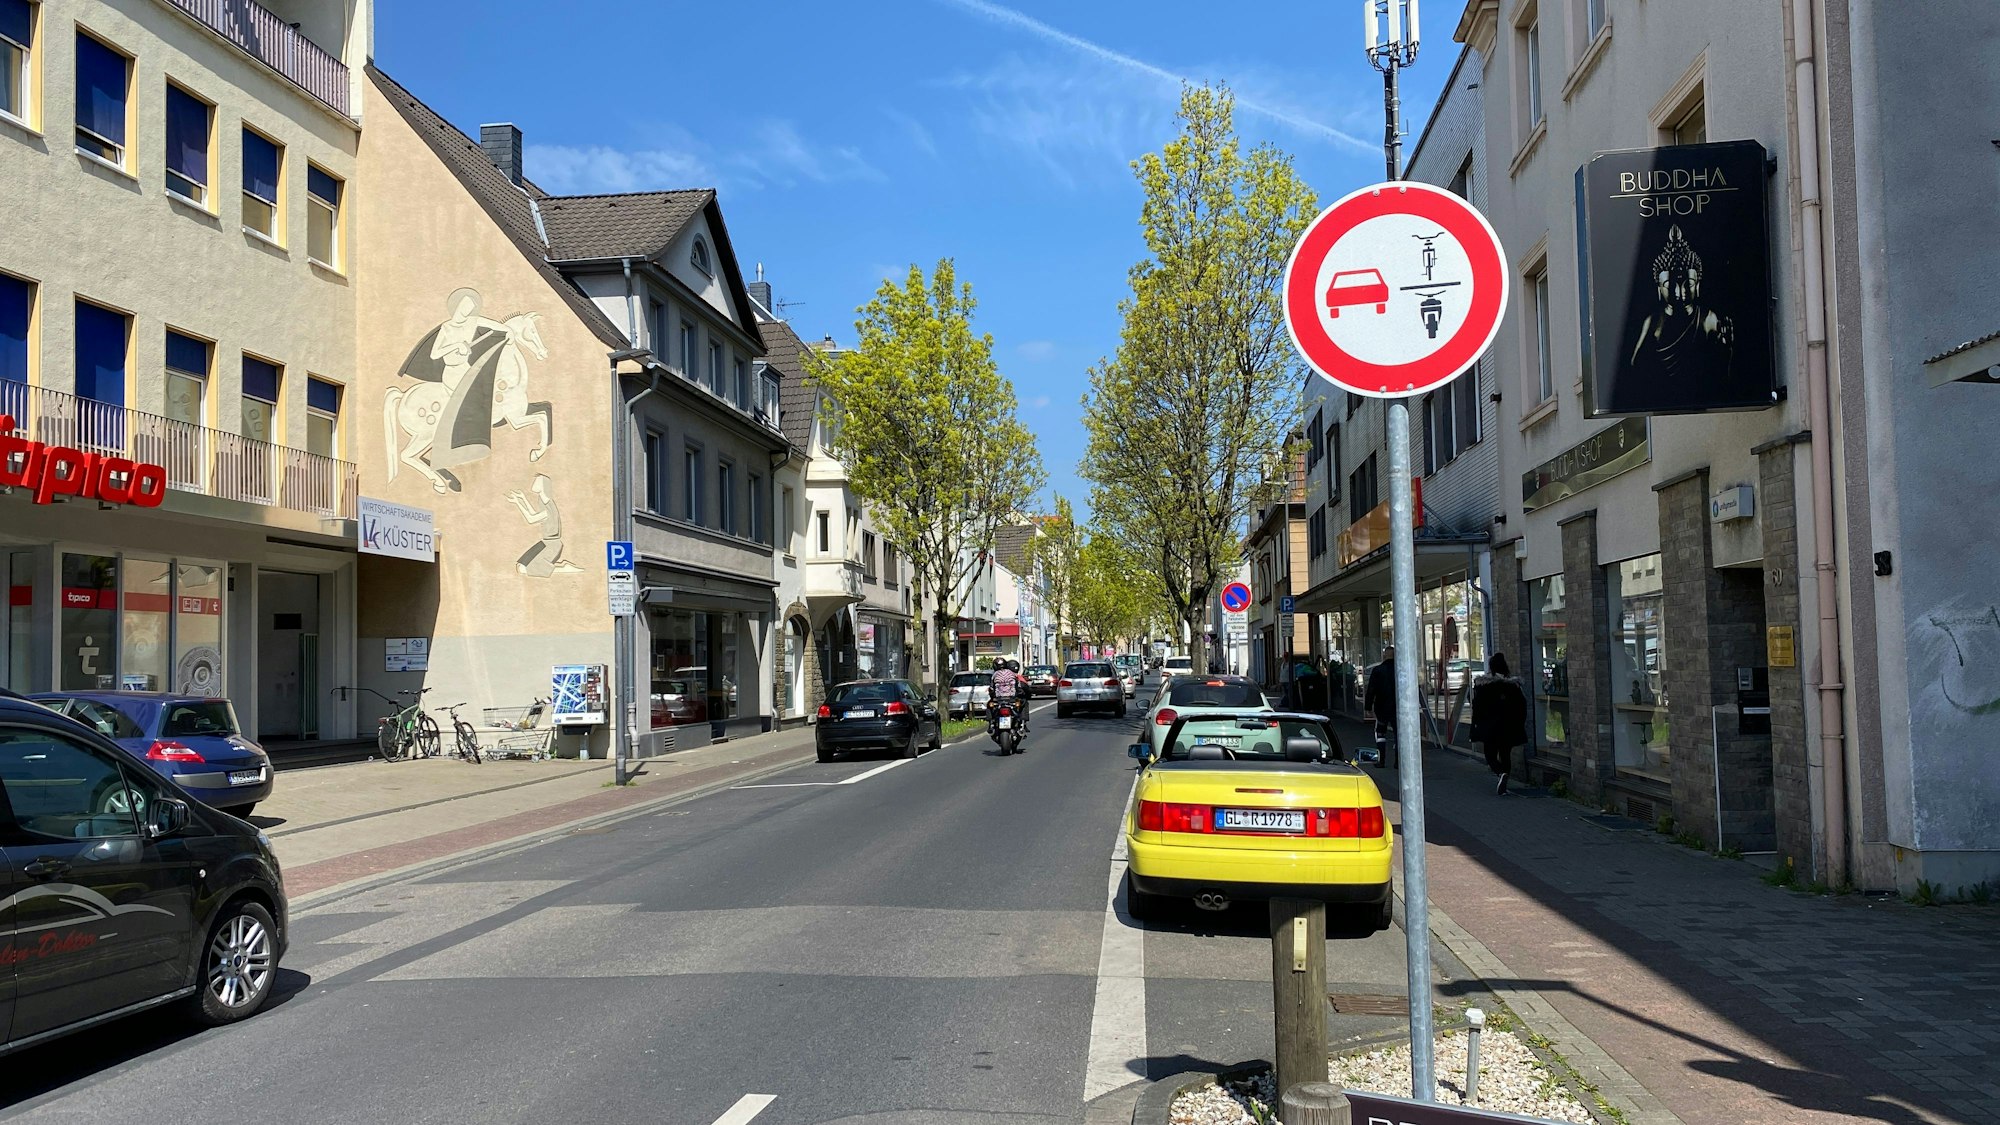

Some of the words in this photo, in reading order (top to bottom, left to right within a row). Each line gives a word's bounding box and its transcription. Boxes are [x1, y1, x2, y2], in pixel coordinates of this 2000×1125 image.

[1620, 167, 1727, 192] BUDDHA
[1639, 194, 1710, 217] SHOP
[1550, 449, 1580, 481] BUDDHA
[1581, 436, 1603, 467] SHOP
[361, 502, 432, 523] WIRTSCHAFTSAKADEMIE
[383, 525, 432, 552] KÜSTER
[610, 544, 626, 567] P
[67, 592, 91, 602] tipico
[1283, 598, 1291, 611] P
[1225, 811, 1241, 825] GL
